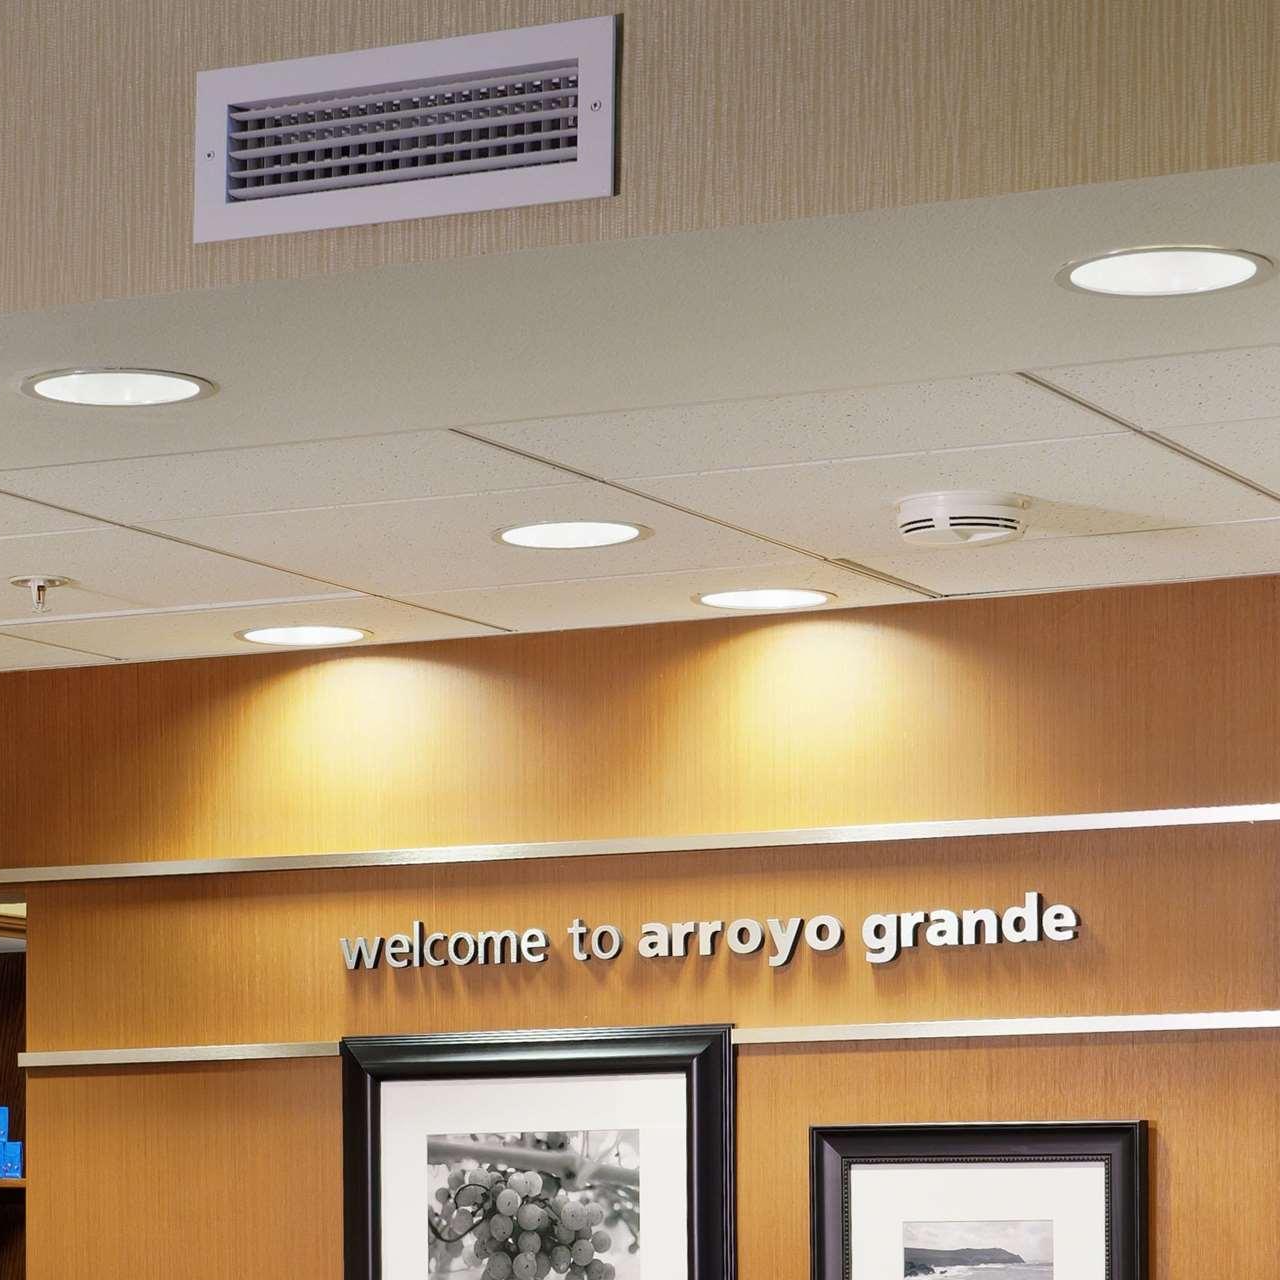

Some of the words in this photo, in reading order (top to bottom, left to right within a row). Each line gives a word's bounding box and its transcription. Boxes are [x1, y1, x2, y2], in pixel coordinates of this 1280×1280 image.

[340, 920, 548, 970] welcome
[568, 917, 624, 961] to
[638, 915, 844, 967] arroyo
[863, 892, 1079, 963] grande
